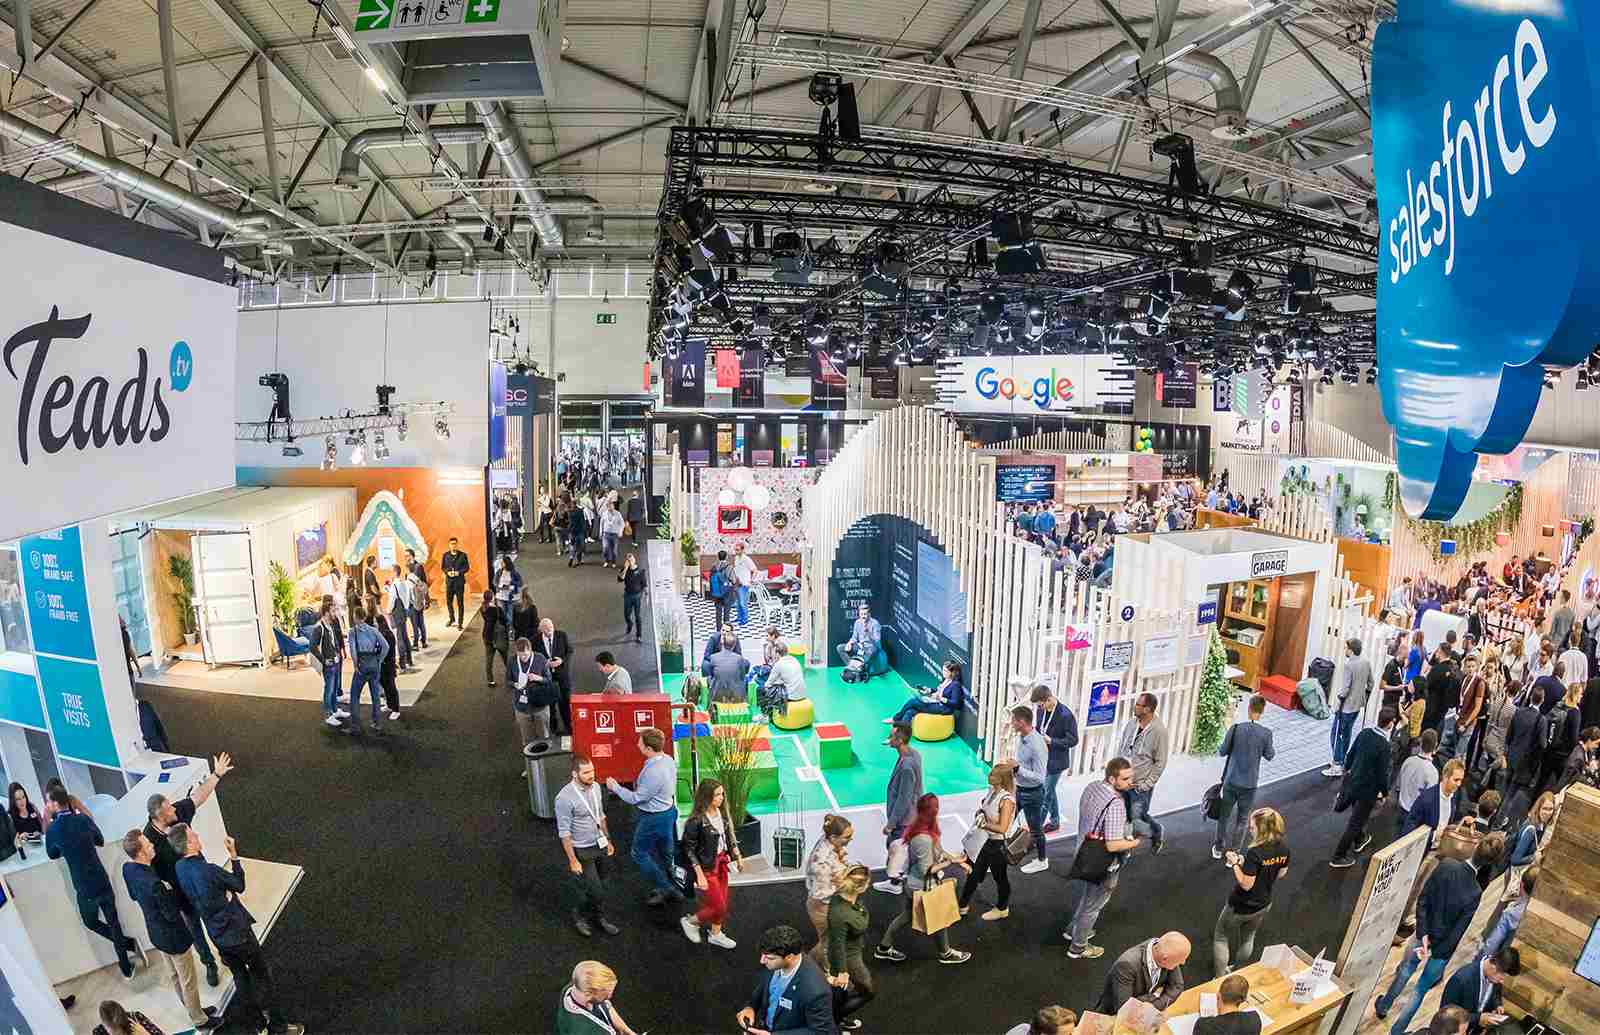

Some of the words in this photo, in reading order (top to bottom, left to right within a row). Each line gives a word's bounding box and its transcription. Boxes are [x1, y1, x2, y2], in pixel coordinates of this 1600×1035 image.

[1389, 18, 1557, 284] salesforce
[3, 304, 170, 466] Teads
[975, 367, 1074, 410] Google
[1253, 559, 1285, 575] GARAGE
[61, 692, 84, 710] TRUE
[64, 710, 91, 728] VISITS
[1377, 860, 1402, 884] WANT
